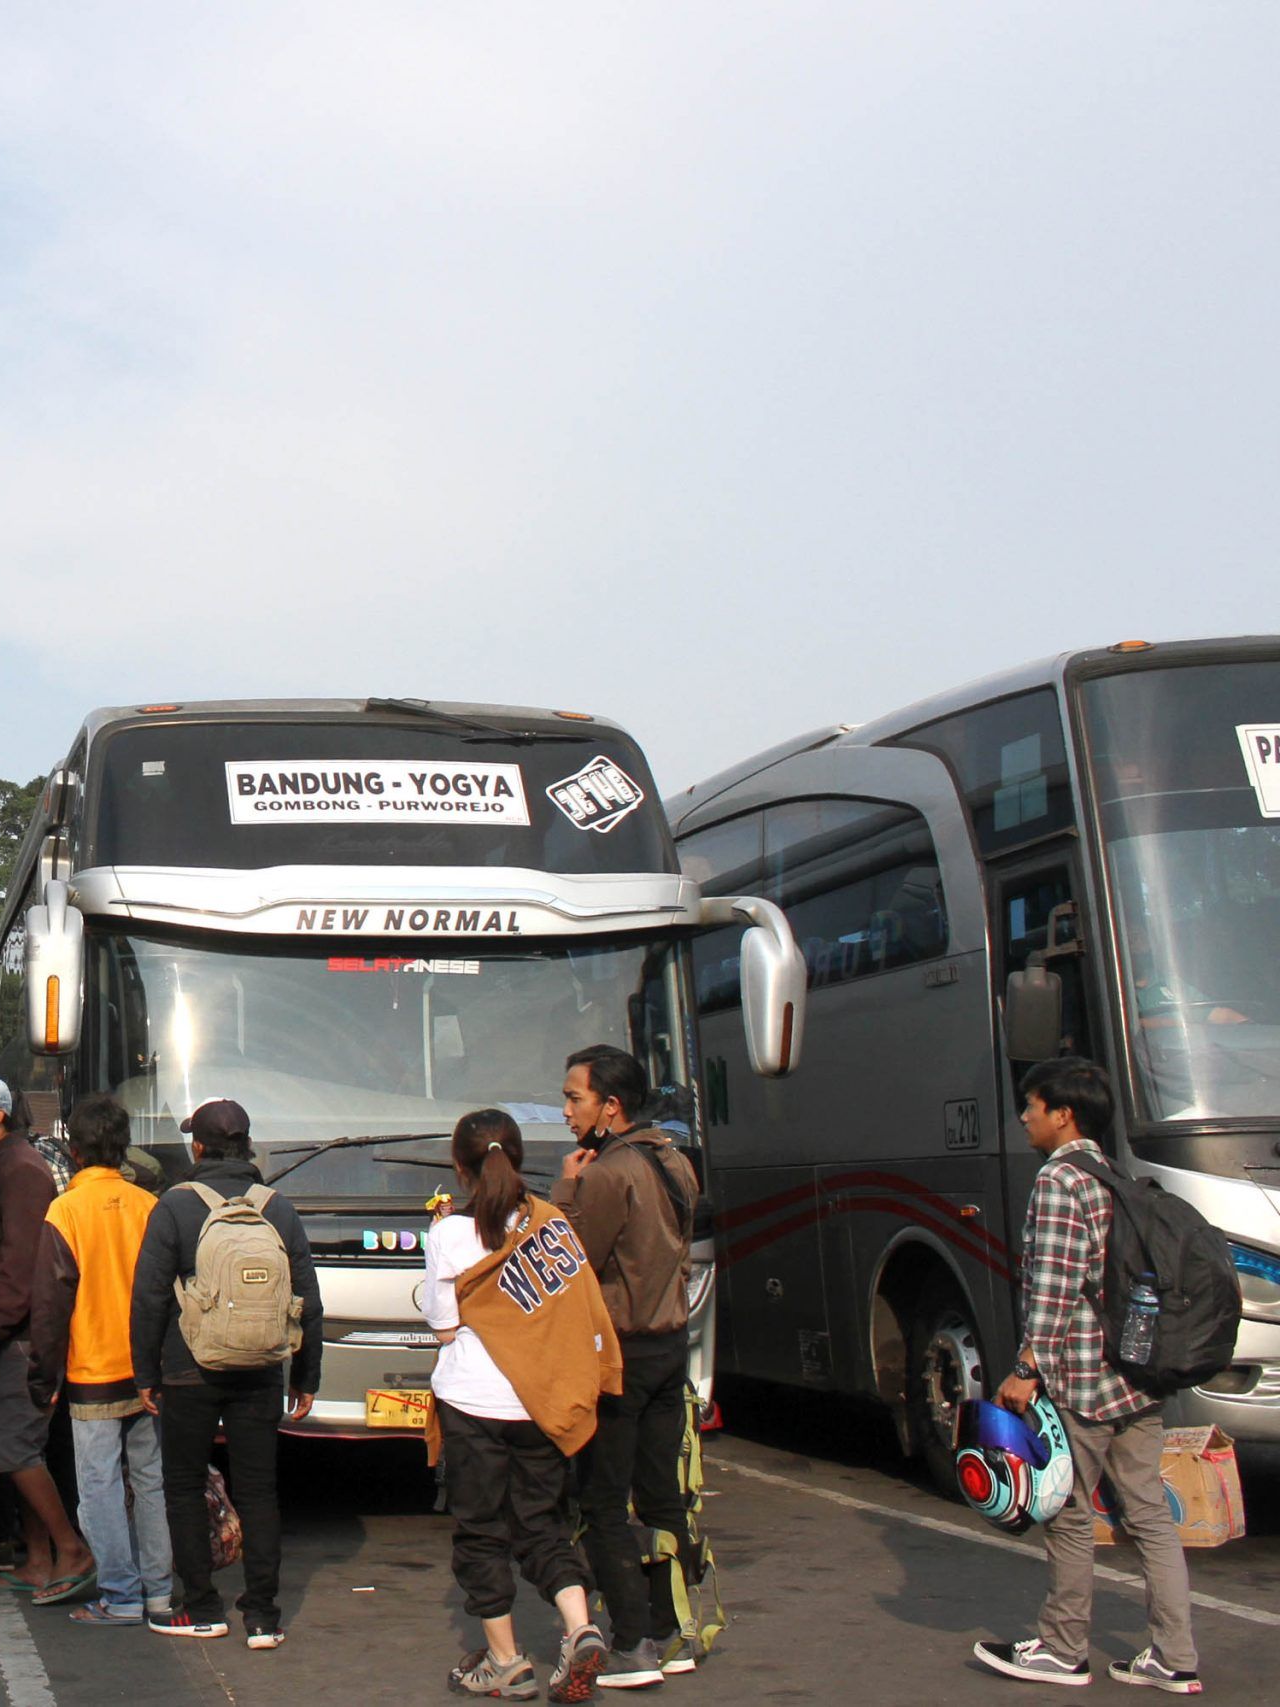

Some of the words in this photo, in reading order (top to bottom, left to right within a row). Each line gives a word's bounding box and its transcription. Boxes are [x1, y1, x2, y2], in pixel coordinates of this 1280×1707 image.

[237, 772, 382, 796] BANDUNG
[409, 772, 514, 798] YOGYA
[254, 800, 361, 811] GOMBONG
[379, 800, 504, 813] PURWOREJO
[296, 909, 369, 930] NEW
[384, 909, 521, 932] NORMAL
[327, 957, 480, 975] SELATANESE
[497, 1217, 587, 1315] WEST
